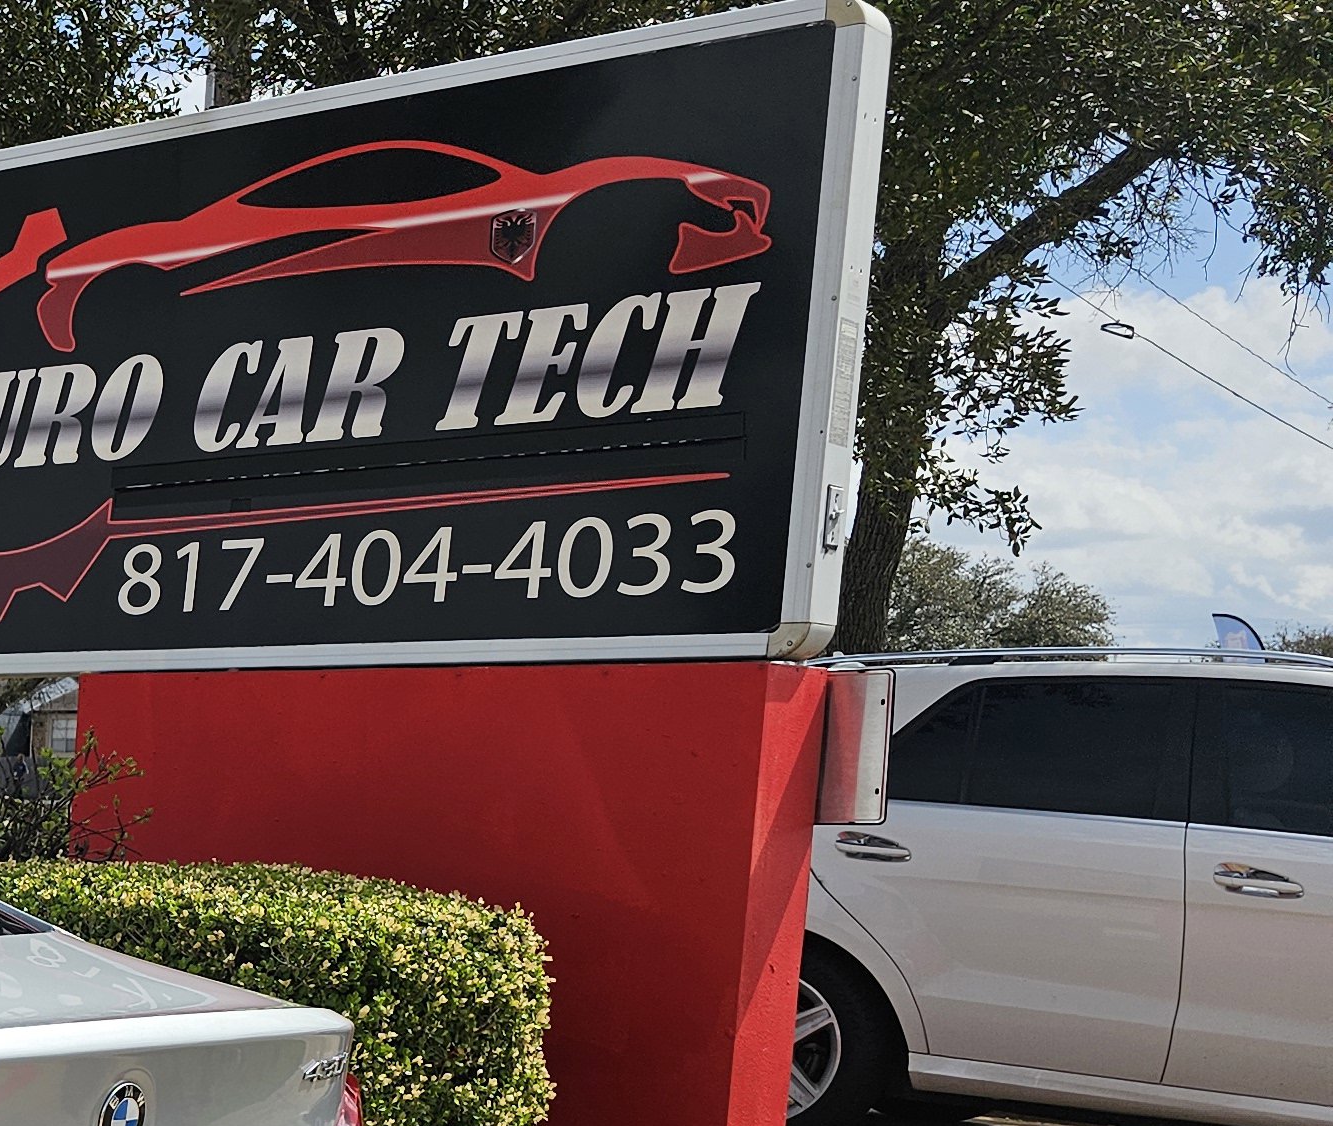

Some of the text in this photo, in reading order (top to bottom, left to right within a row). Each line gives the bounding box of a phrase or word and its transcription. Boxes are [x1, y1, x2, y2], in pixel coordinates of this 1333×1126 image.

[193, 327, 405, 453] CAR
[435, 282, 762, 431] TECH
[117, 509, 737, 616] 817-404-4033
[108, 1085, 145, 1109] BMW
